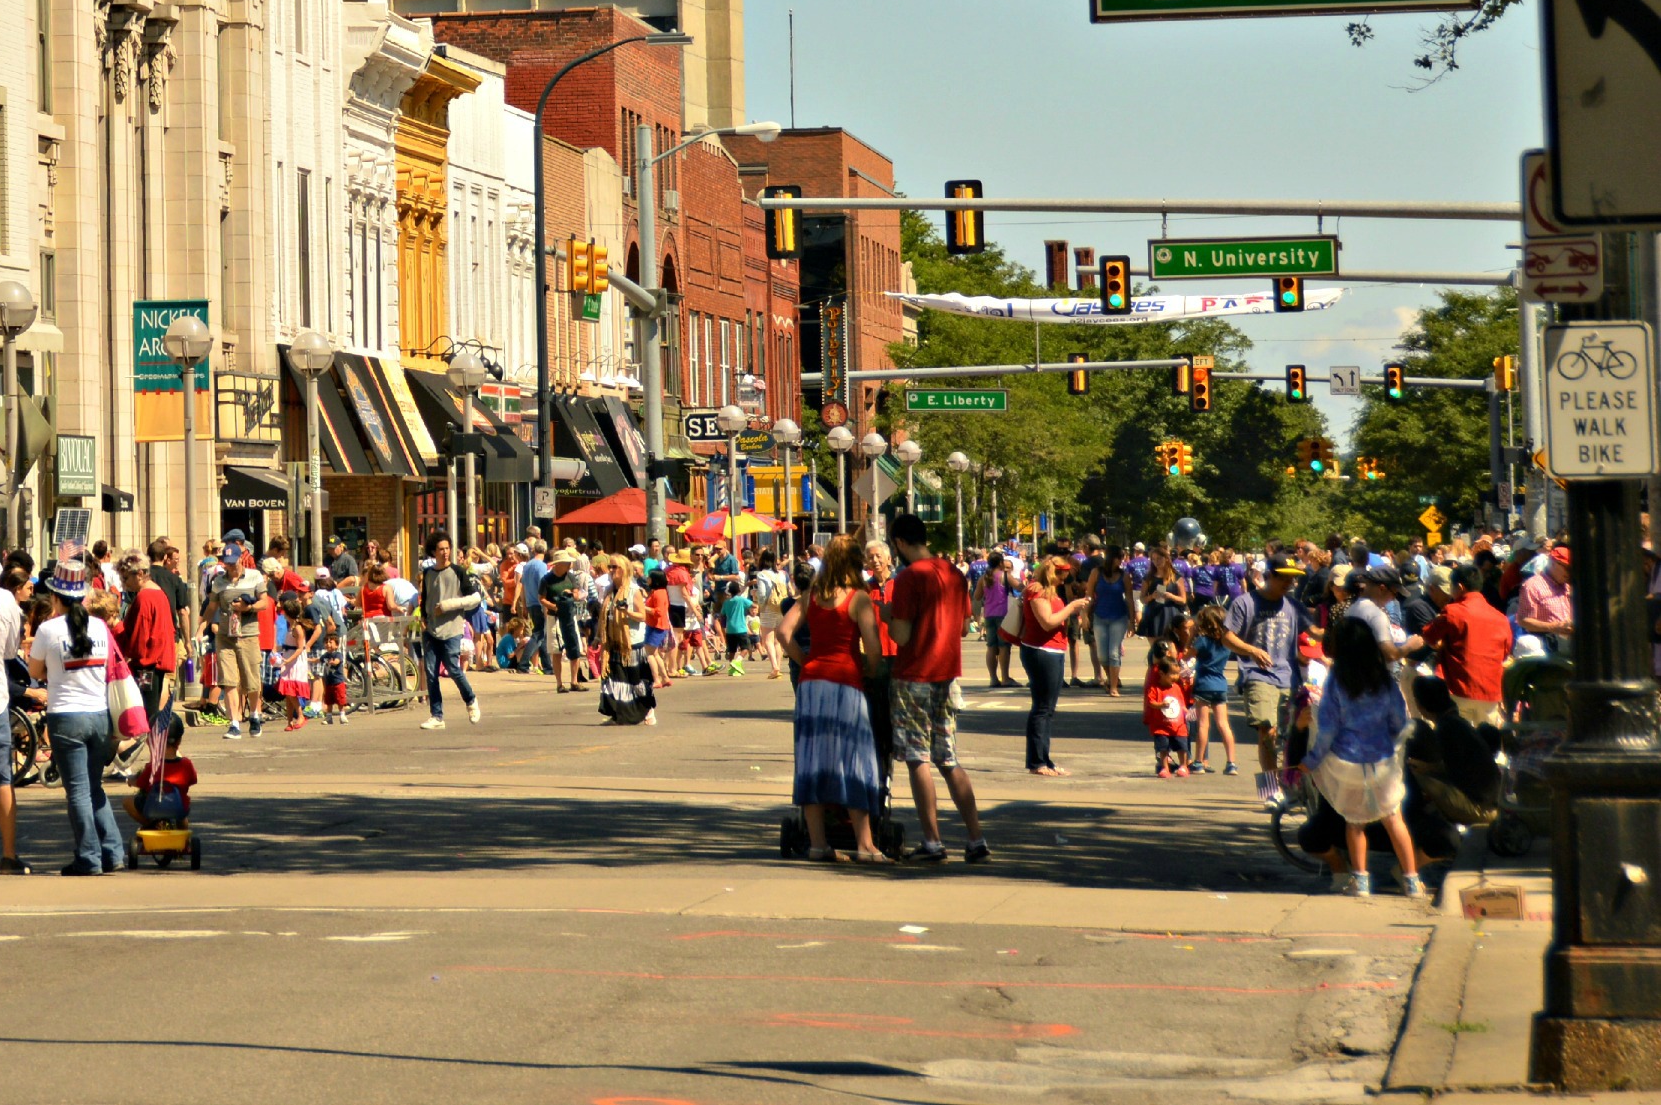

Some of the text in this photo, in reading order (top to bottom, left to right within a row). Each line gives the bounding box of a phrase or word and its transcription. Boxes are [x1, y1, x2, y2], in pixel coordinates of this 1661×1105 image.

[1183, 247, 1320, 269] N. University
[1051, 298, 1166, 318] Jayees
[927, 395, 995, 408] E. Liberty
[1559, 390, 1638, 411] PLEASE
[688, 417, 727, 438] SE
[1572, 417, 1627, 437] WALK
[60, 438, 93, 473] BIVOUAC
[1578, 443, 1625, 464] BIKE
[554, 487, 602, 496] yogurtrush
[224, 498, 286, 508] VAN BOVEN
